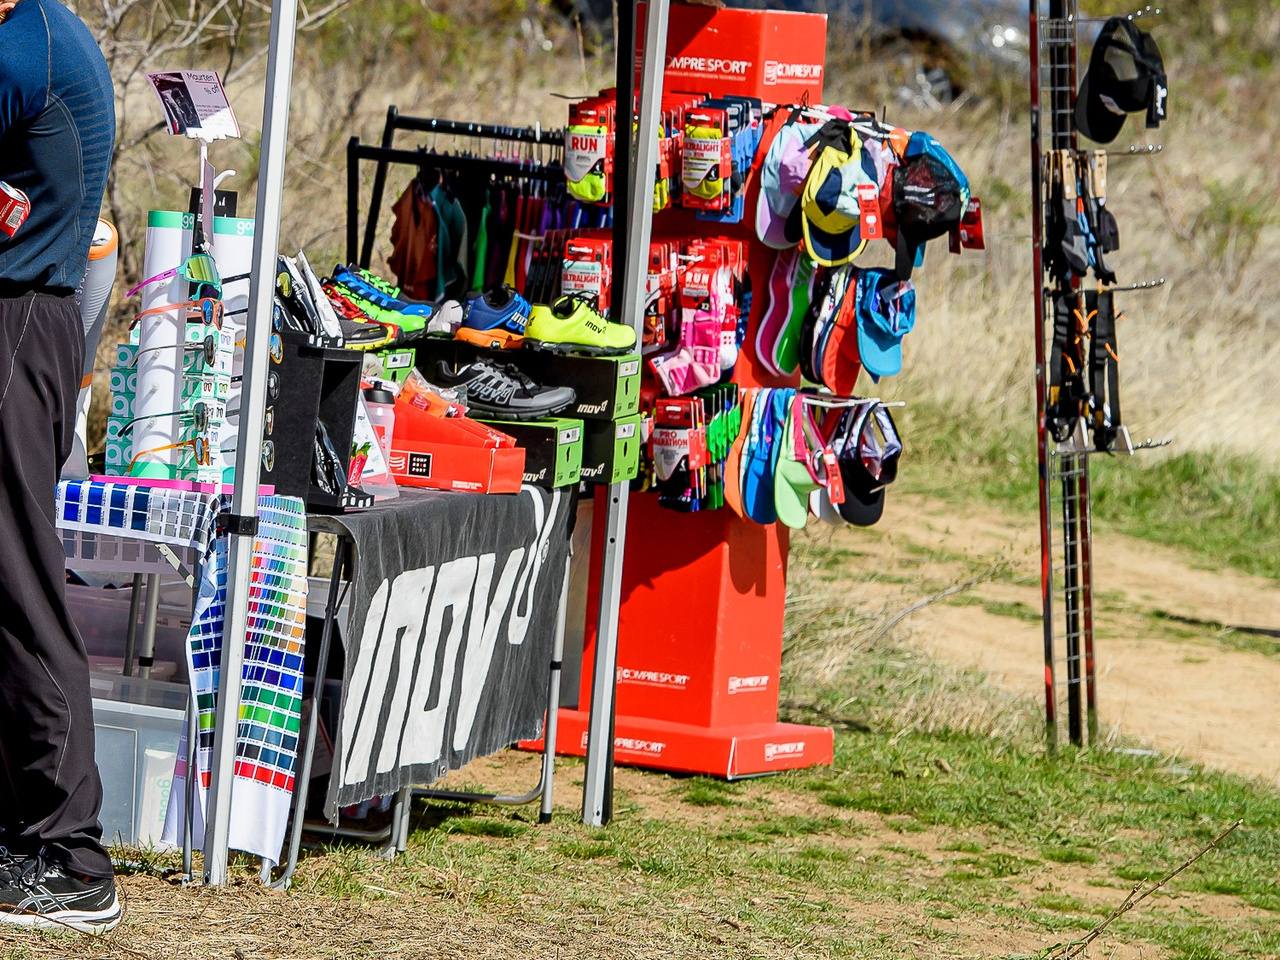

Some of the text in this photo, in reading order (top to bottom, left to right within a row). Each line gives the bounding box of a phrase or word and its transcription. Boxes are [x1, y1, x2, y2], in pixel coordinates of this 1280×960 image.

[186, 72, 215, 82] Maurten
[212, 84, 221, 94] off
[572, 136, 598, 152] RUN
[685, 272, 710, 284] RUN
[660, 431, 677, 439] PRO
